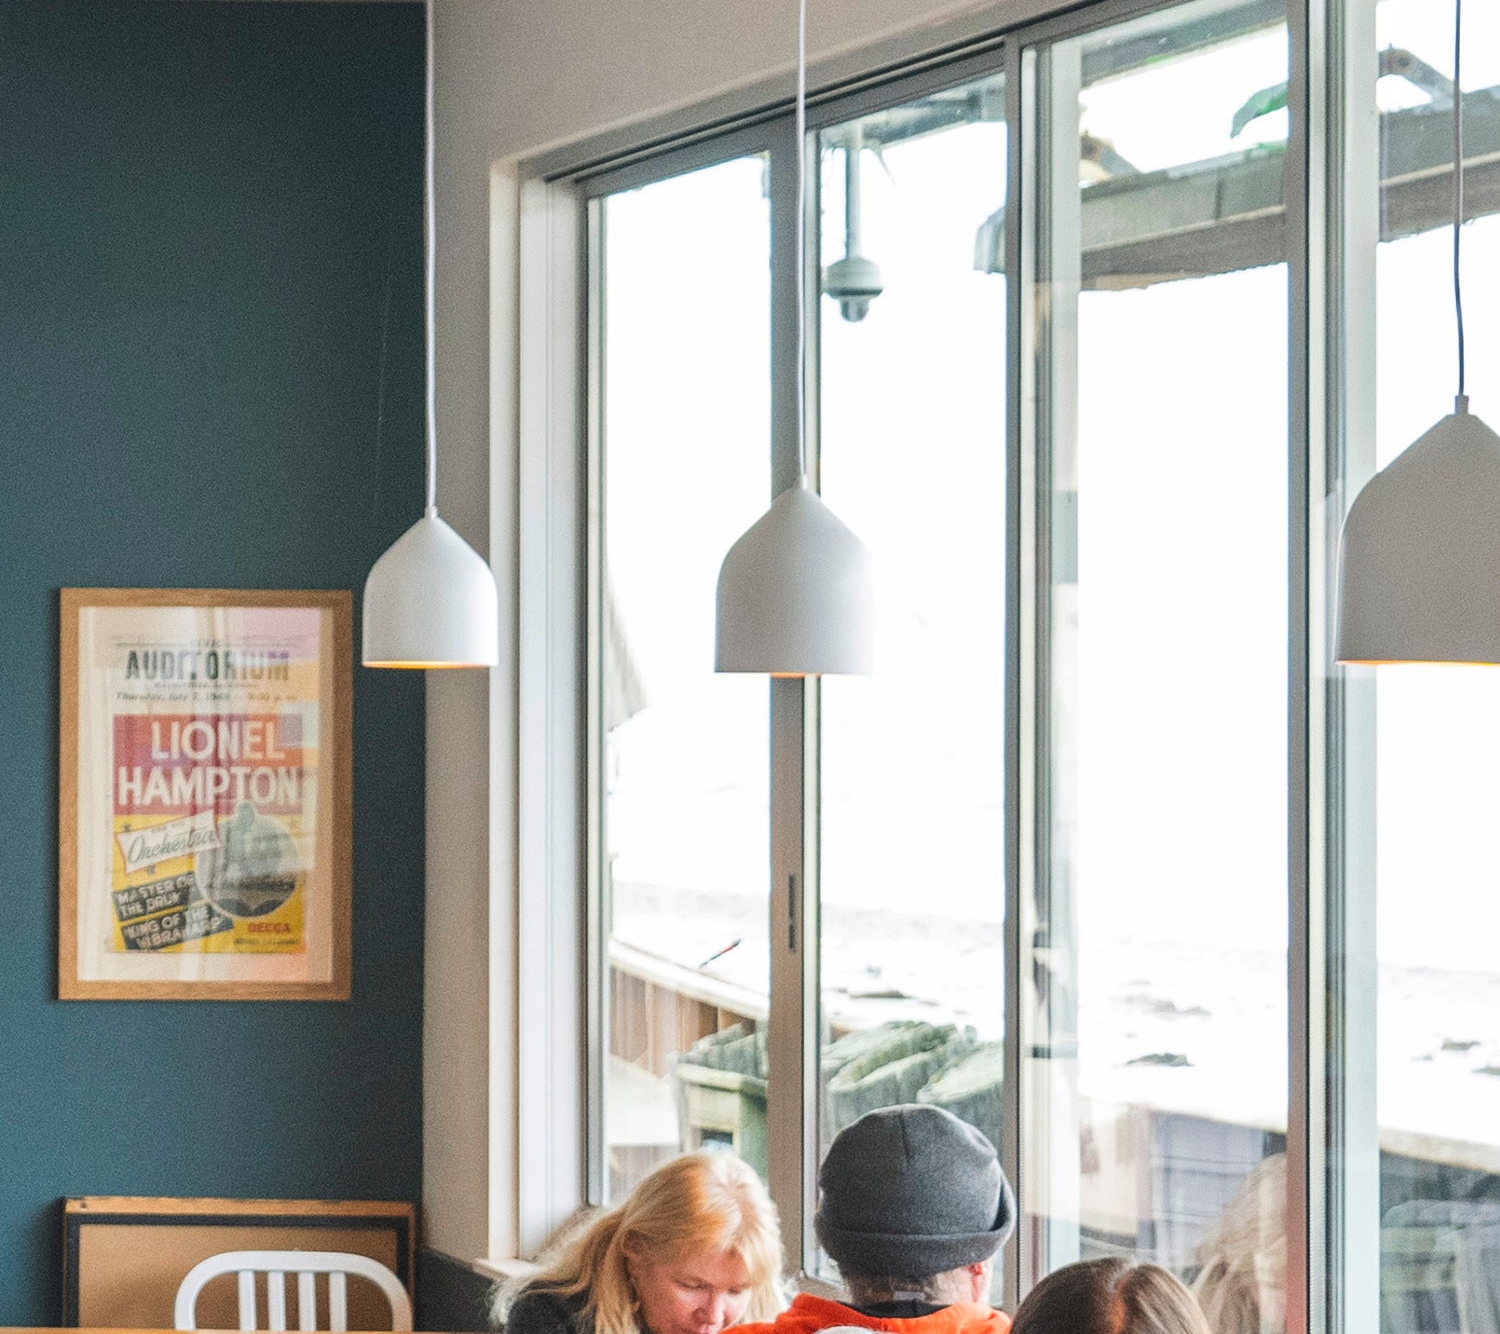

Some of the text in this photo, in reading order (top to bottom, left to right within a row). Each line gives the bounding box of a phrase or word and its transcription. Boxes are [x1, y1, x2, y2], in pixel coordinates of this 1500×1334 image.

[126, 650, 289, 681] AUDITORIUM
[151, 720, 286, 760] LIONEL
[118, 766, 300, 806] HAMPTON
[127, 827, 217, 864] Orchestra
[117, 880, 176, 903] MASTER
[119, 903, 144, 917] THE
[124, 920, 158, 941] KING
[161, 913, 180, 930] OF
[247, 922, 291, 933] DECCA
